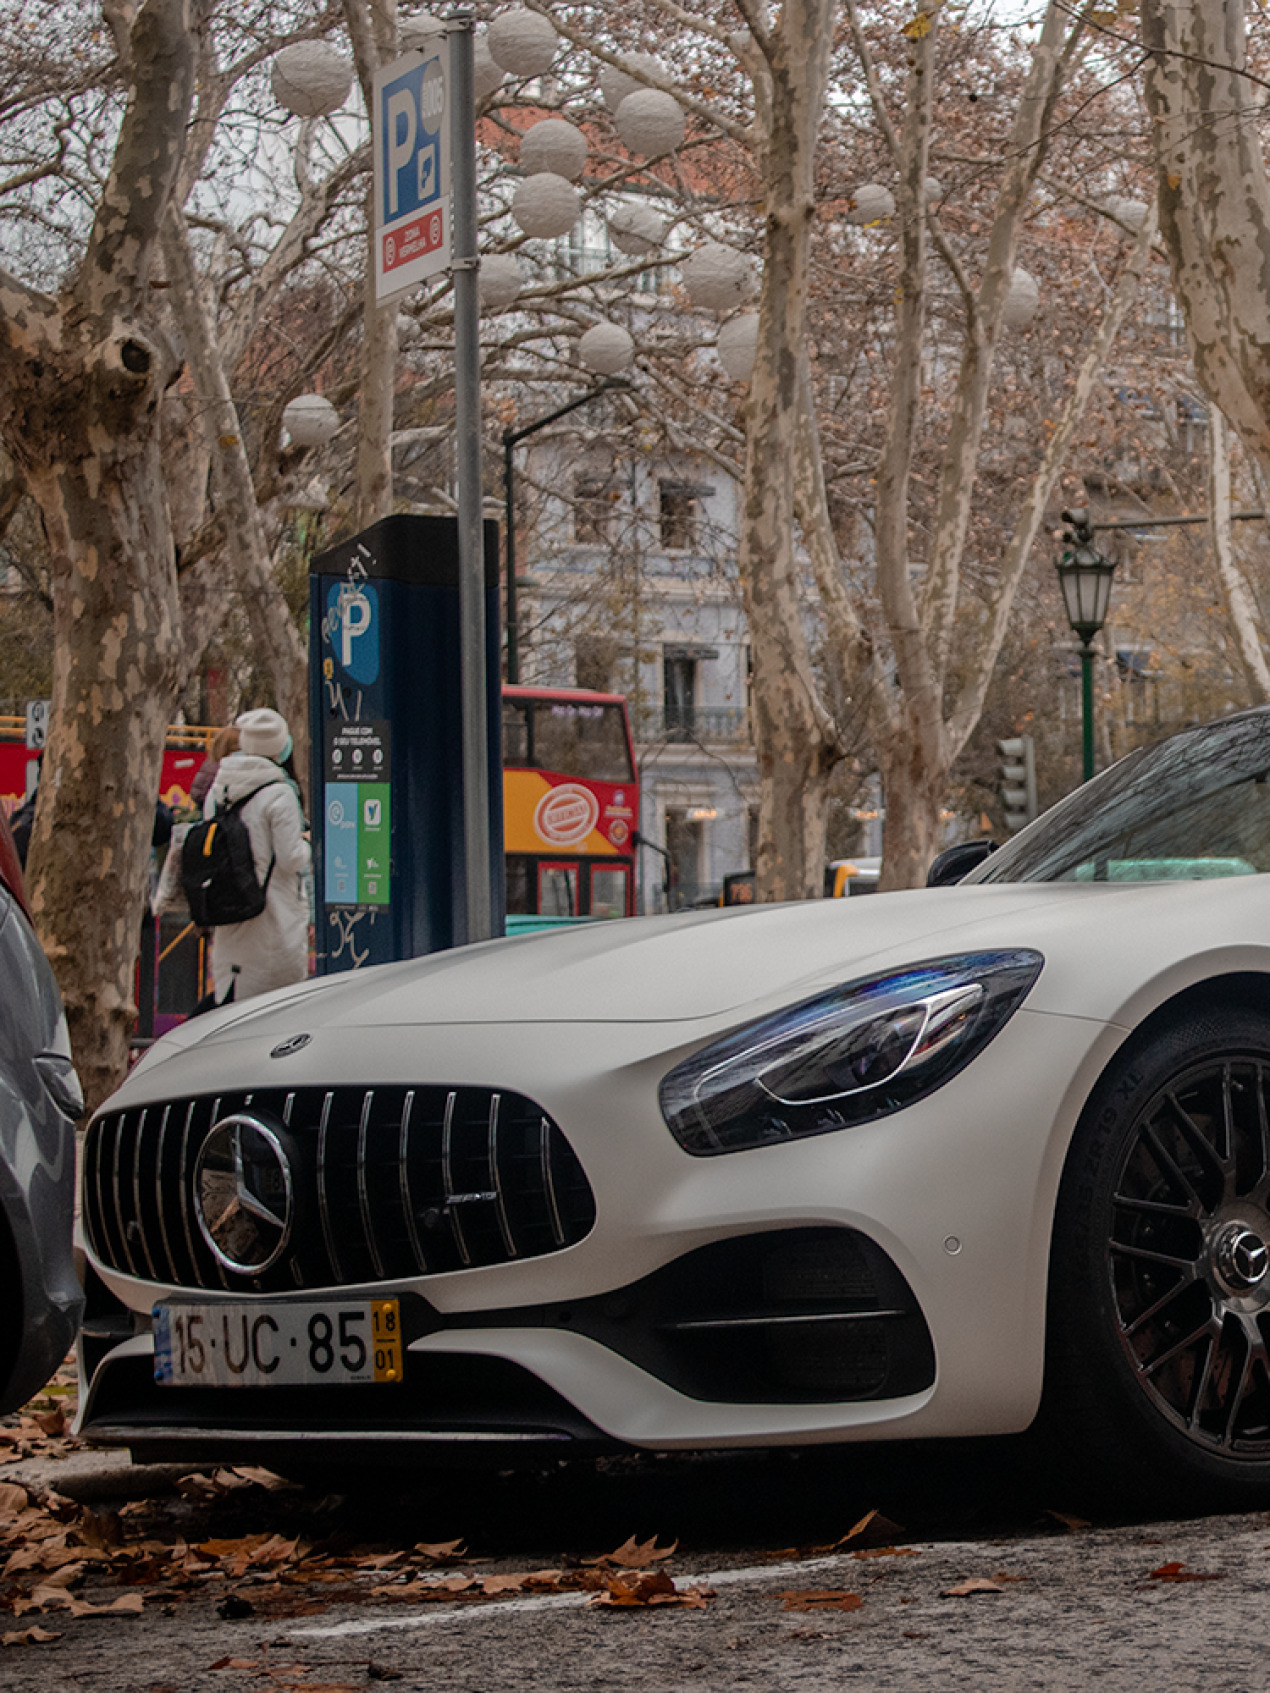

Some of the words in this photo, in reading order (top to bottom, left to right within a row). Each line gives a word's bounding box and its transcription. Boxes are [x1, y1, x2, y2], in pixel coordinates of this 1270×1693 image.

[388, 88, 417, 215] P
[342, 593, 371, 666] P
[374, 1311, 396, 1332] 18
[375, 1349, 394, 1370] 01
